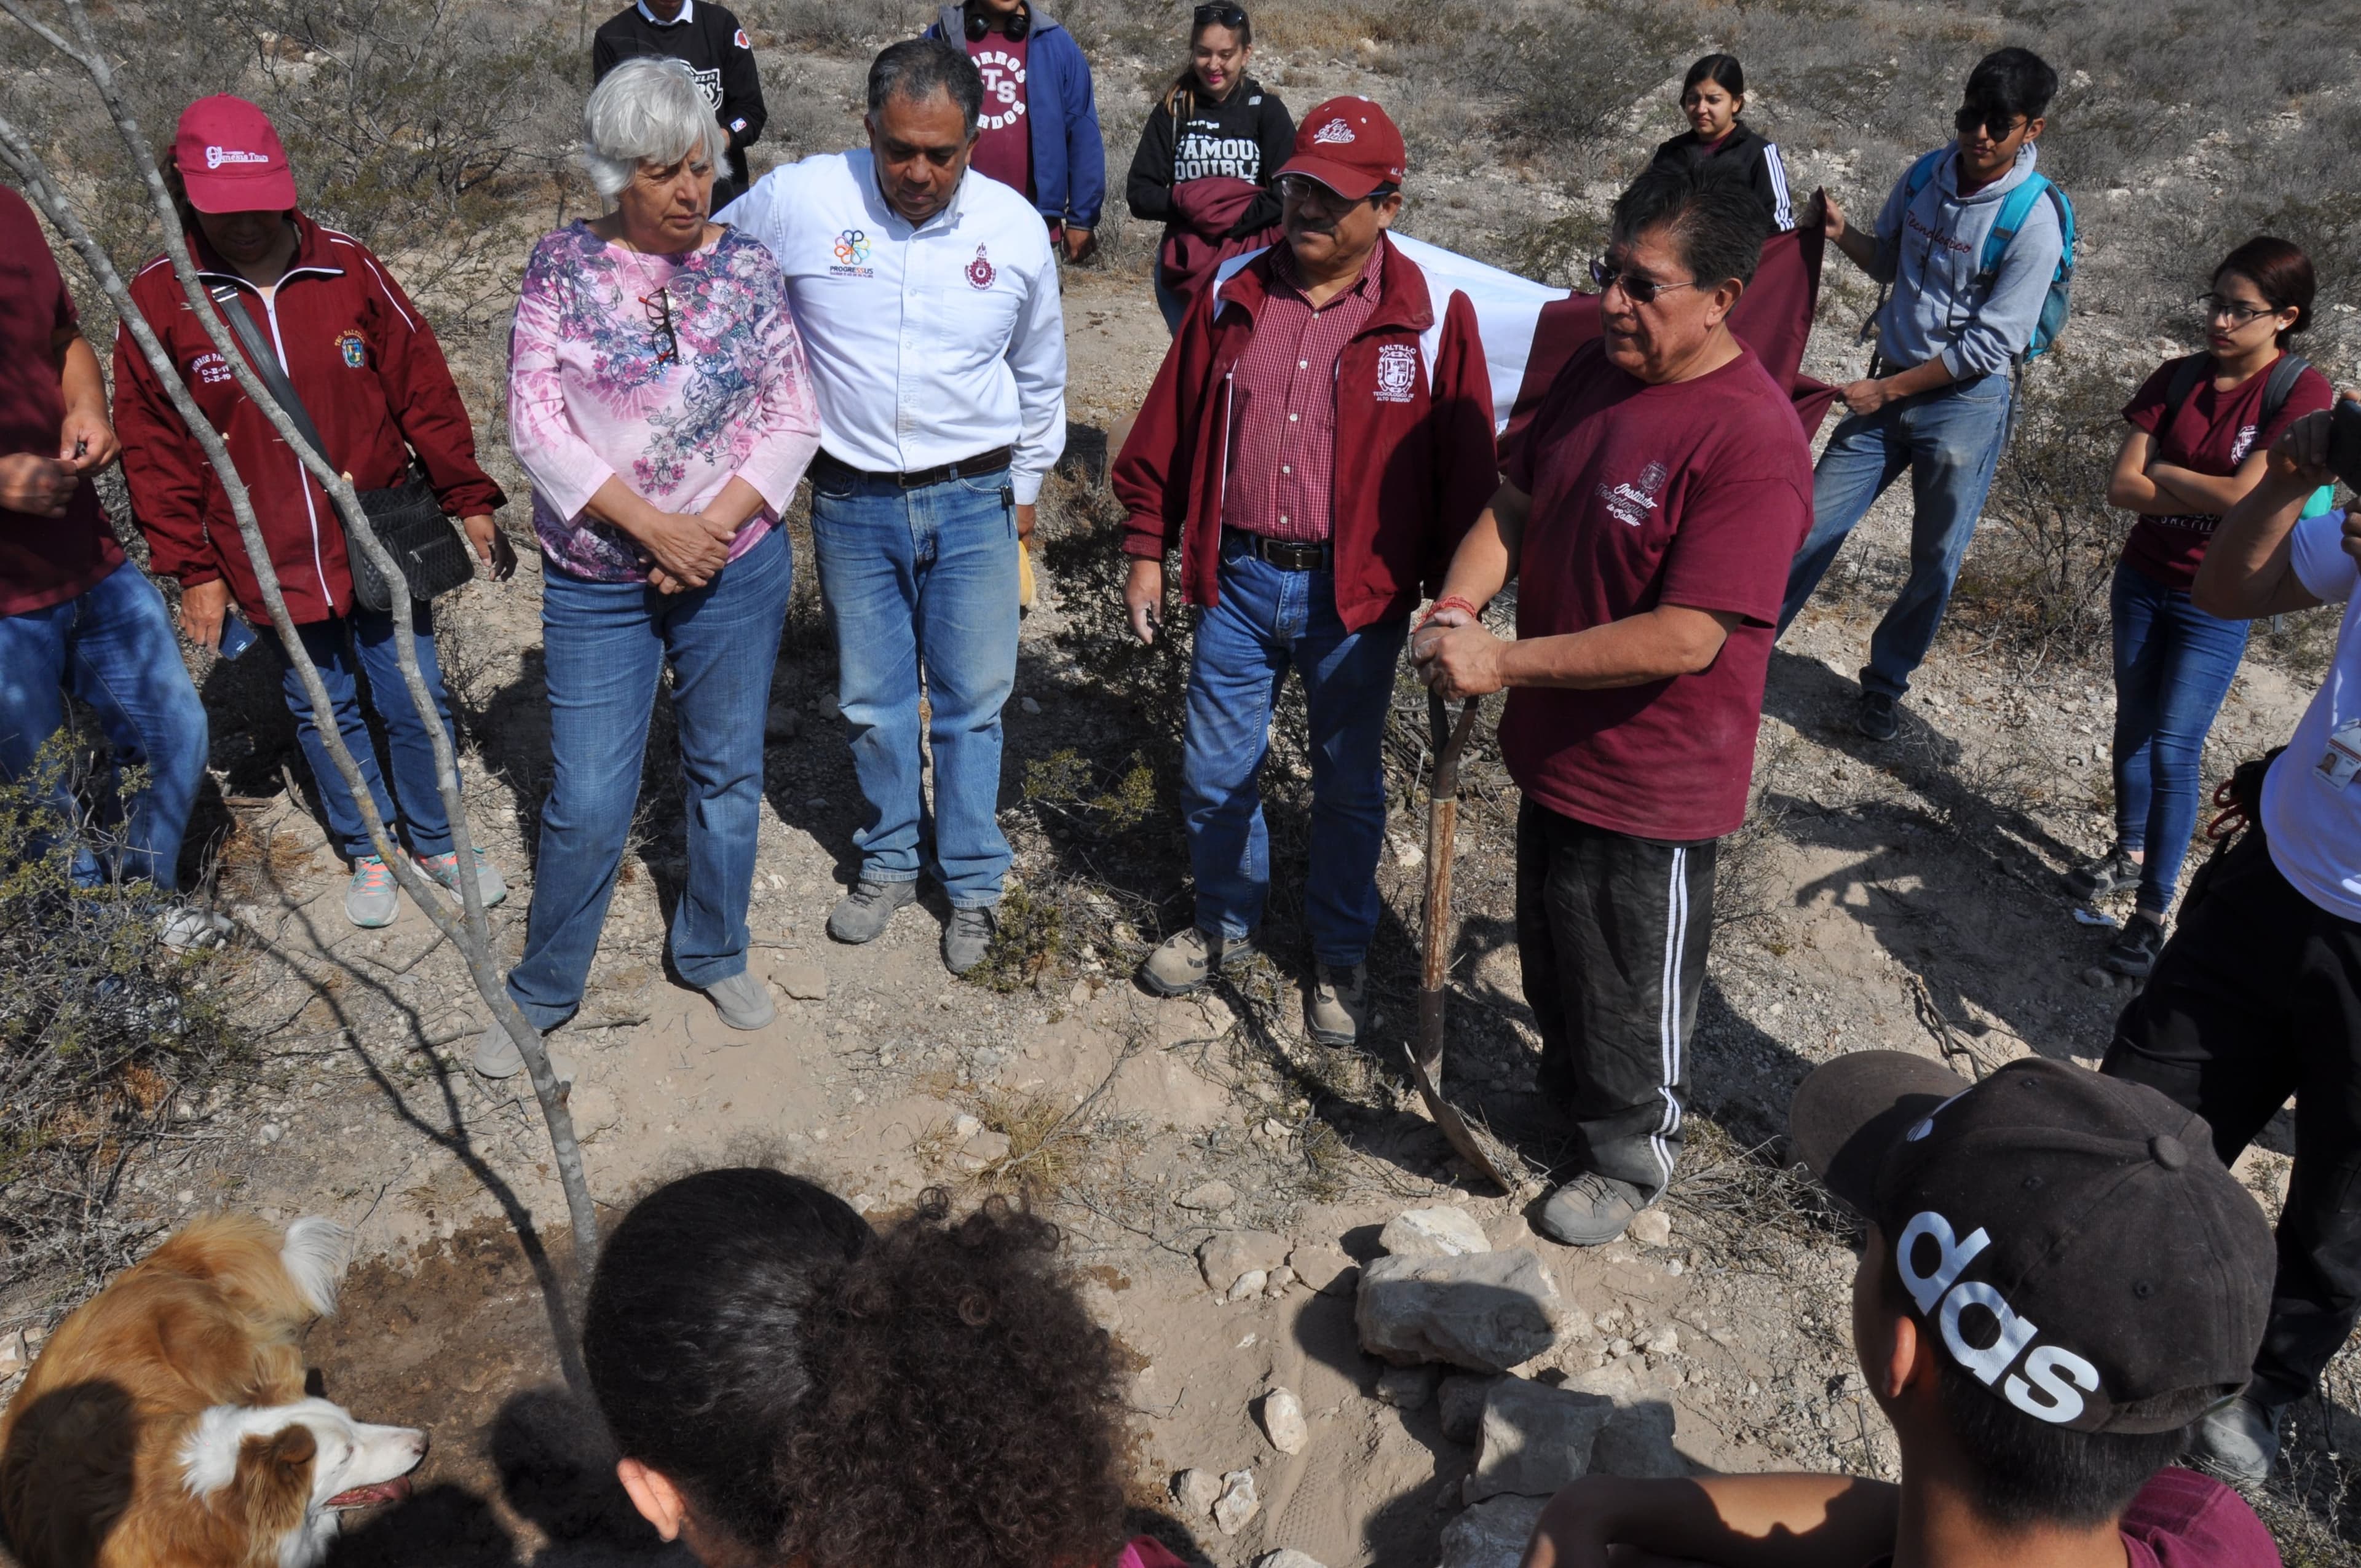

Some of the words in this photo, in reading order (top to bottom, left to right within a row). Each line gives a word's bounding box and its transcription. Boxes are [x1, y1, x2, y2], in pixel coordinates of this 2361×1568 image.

[971, 50, 1026, 83] RROS
[982, 68, 1016, 103] TS
[976, 100, 1026, 129] RDOS
[1174, 160, 1260, 181] DOUBLE
[829, 266, 874, 274] PROGRESSUS
[1378, 344, 1417, 354] SALTILLO
[1594, 483, 1650, 520] Tecnologico
[1614, 483, 1658, 509] Instituto
